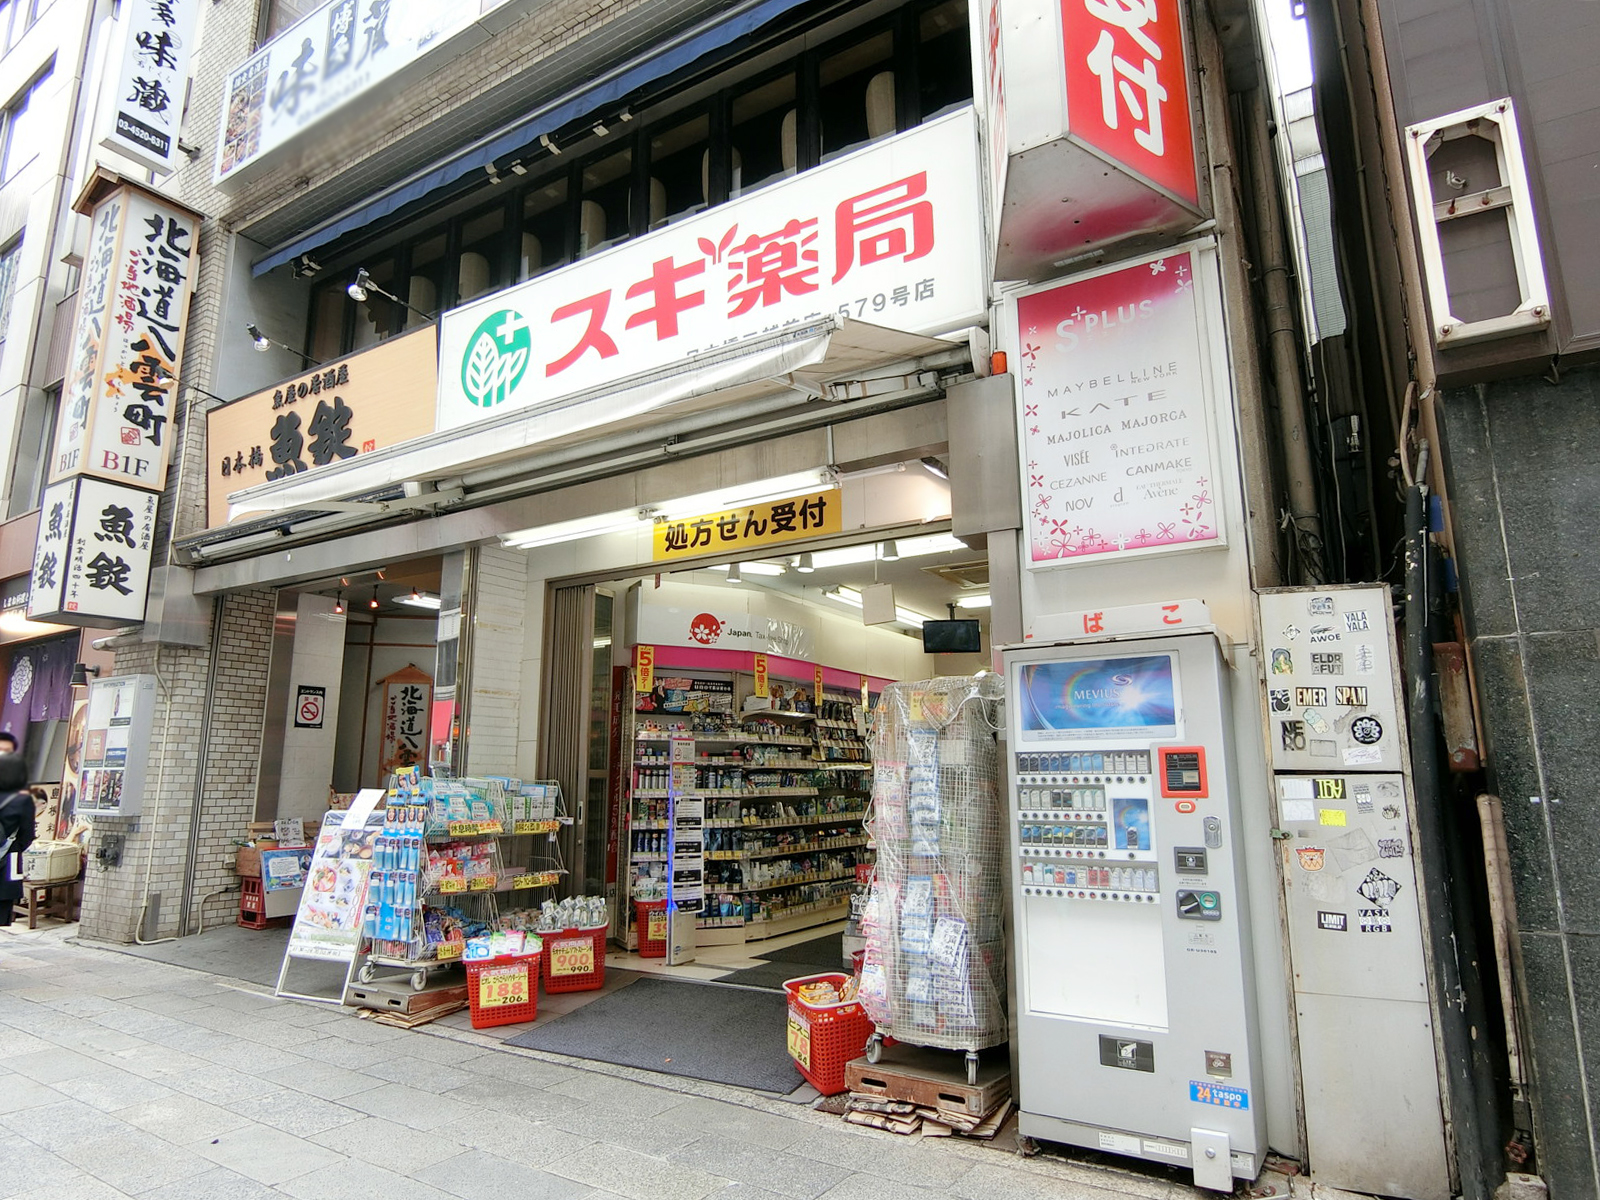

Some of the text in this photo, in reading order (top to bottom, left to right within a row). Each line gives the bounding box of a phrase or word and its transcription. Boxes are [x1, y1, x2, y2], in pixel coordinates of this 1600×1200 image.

[117, 118, 170, 152] 03-4520-6311
[545, 169, 936, 378] スギ薬局
[123, 213, 192, 447] 北海道八雲町
[272, 363, 350, 411] 魚屋の居酒屋
[1047, 361, 1178, 398] MAYBELLINE
[1047, 409, 1188, 445] MAJOLICA MAJORCA
[58, 448, 149, 477] B1F B1F
[221, 445, 264, 478] 日本橋
[1049, 456, 1192, 491] CEZANNE CANMAKE
[1065, 496, 1094, 512] NOV
[664, 495, 828, 552] 処方せん受付
[1344, 611, 1368, 622] YALA
[1346, 620, 1370, 632] YALA
[1310, 633, 1342, 644] AWOE
[1073, 688, 1121, 701] MEVIUS
[1297, 687, 1367, 706] EMER SPAM
[1358, 909, 1388, 917] VASK
[1364, 924, 1389, 932] RGB
[556, 953, 590, 967] 900
[570, 965, 590, 973] 990
[486, 981, 524, 999] 188
[501, 995, 523, 1005] 206
[1212, 1088, 1243, 1102] taspo
